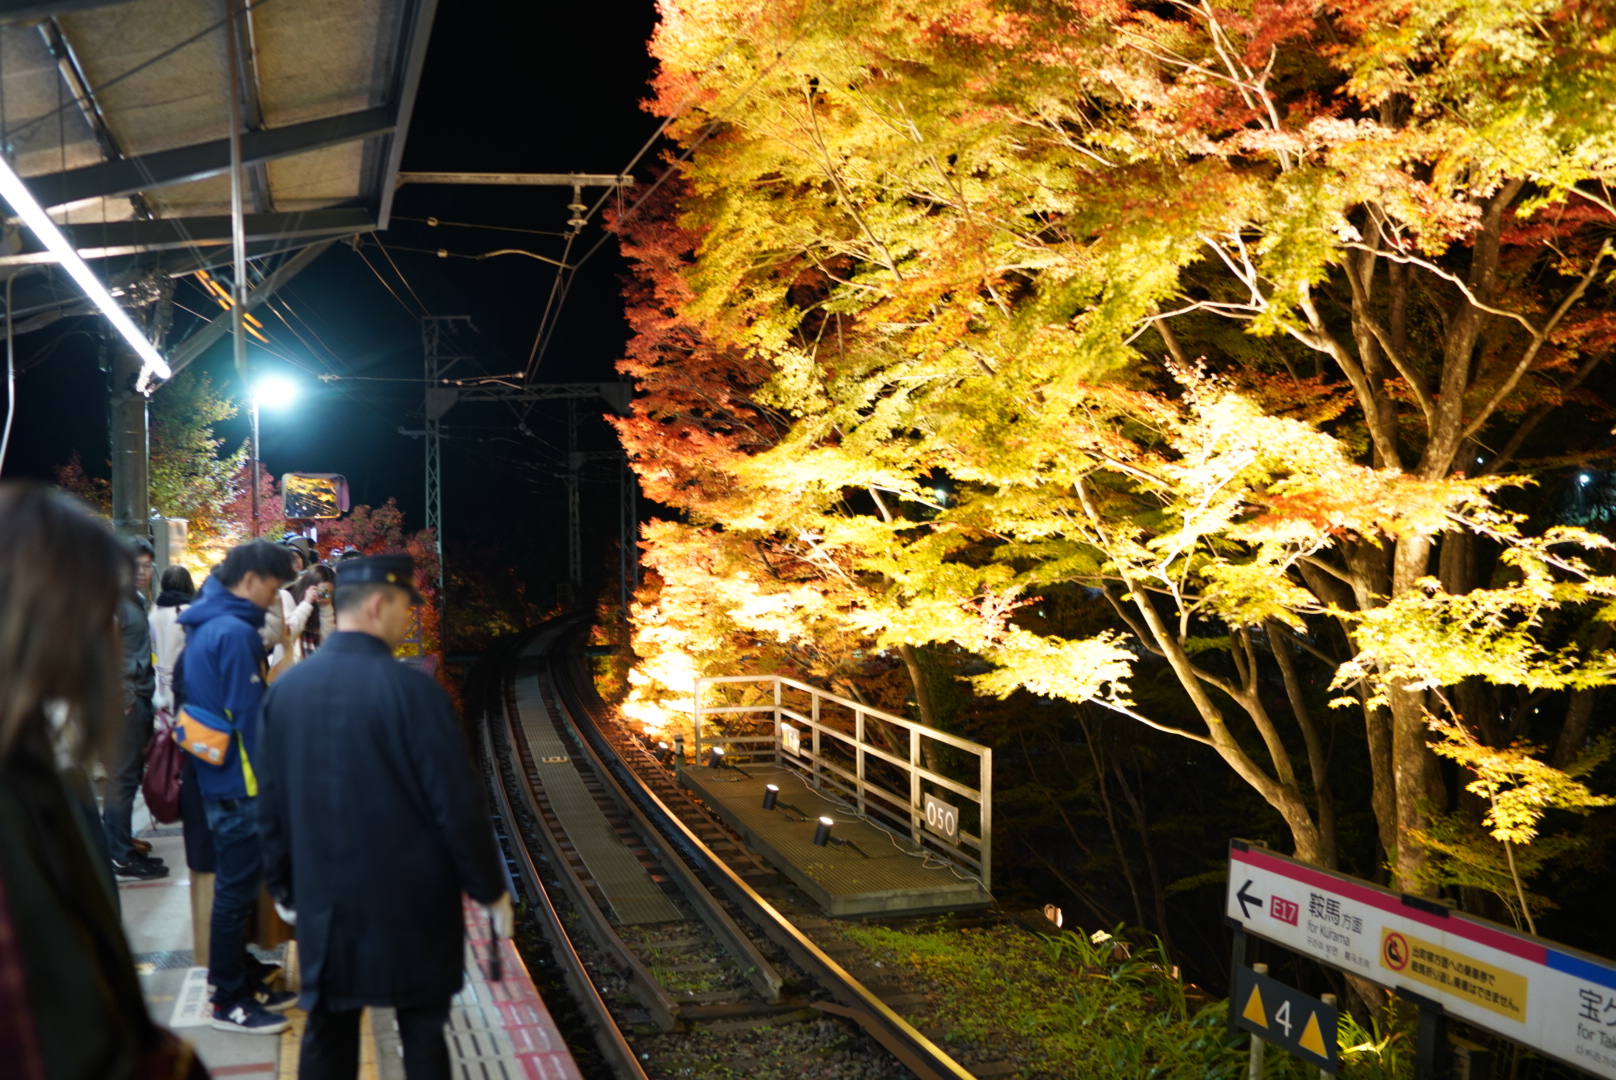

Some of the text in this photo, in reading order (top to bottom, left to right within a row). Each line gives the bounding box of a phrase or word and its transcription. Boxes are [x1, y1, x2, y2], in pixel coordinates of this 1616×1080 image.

[926, 801, 955, 837] 050
[1273, 899, 1297, 922] E17
[1309, 892, 1362, 935] 鞍馬方面
[1308, 920, 1350, 947] for Kurama
[1274, 1000, 1292, 1037] 4
[1577, 1023, 1595, 1041] for
